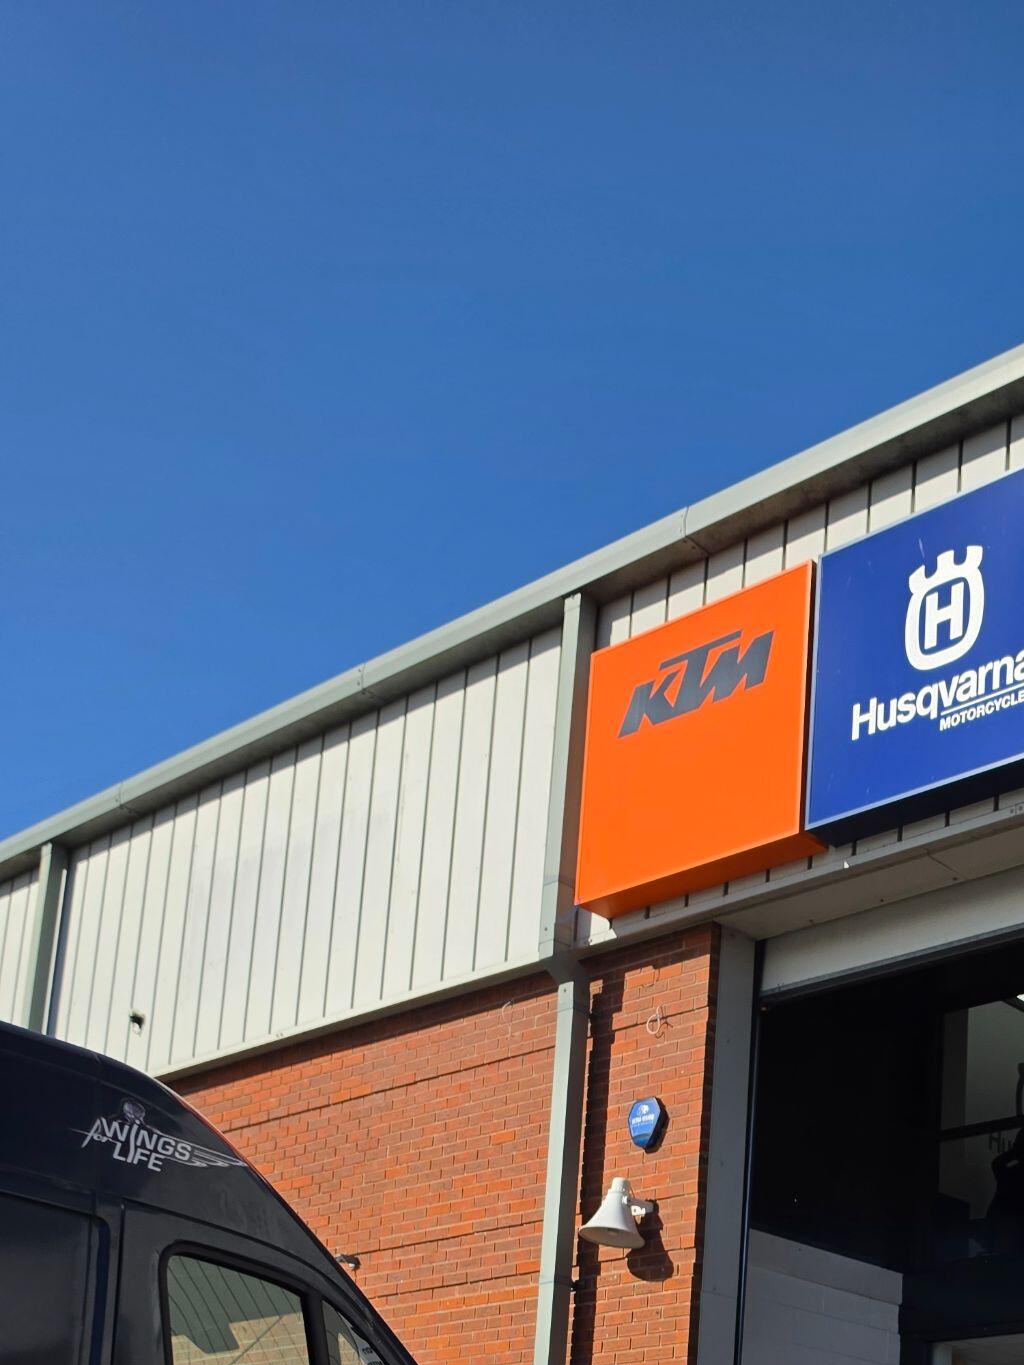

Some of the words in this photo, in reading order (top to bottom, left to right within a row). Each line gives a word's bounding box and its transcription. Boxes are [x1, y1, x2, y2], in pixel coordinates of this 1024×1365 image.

[616, 629, 775, 738] KTM
[101, 1117, 192, 1164] WINGS
[112, 1142, 164, 1173] LIFE
